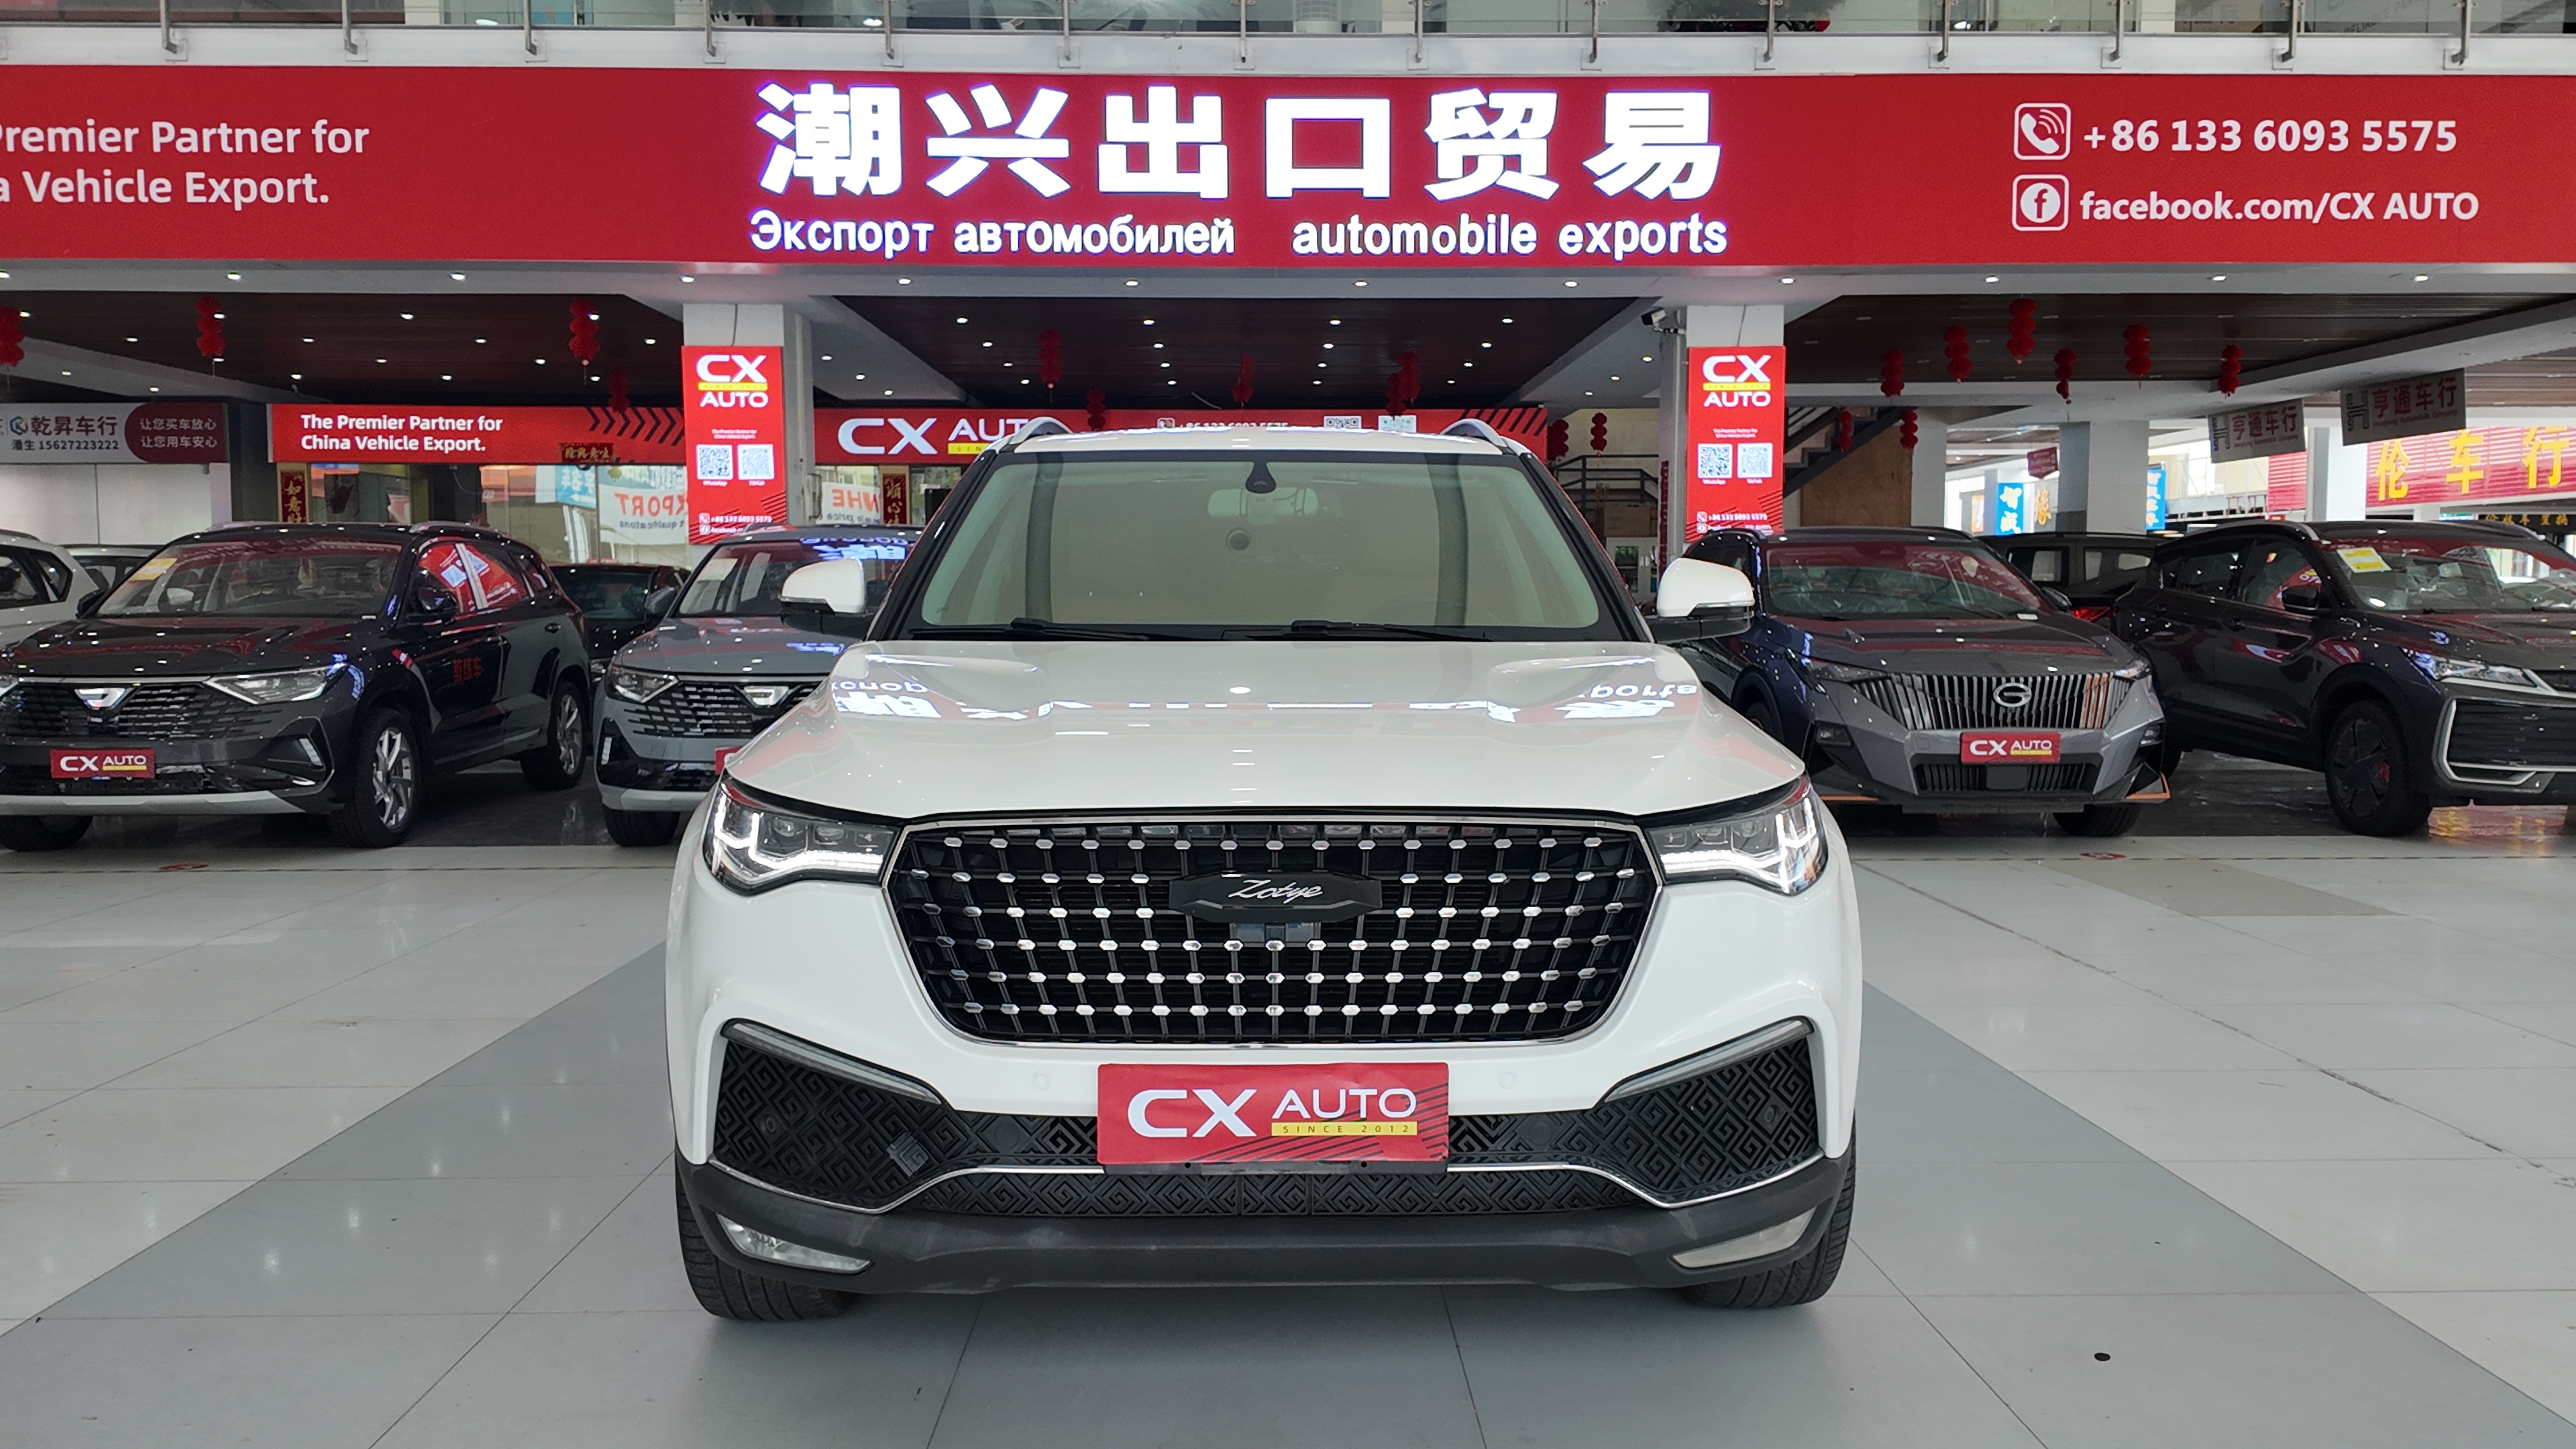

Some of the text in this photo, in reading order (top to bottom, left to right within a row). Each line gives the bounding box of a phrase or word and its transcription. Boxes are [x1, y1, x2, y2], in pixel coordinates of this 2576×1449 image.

[0, 119, 370, 153] remier Partner for
[755, 83, 1721, 201] 潮兴出口贸易
[2084, 119, 2457, 152] +86 133 6093 5575
[22, 168, 172, 203] Vehicle
[186, 172, 329, 211] Export.
[2080, 191, 2479, 223] facebook.com/CX AUTO
[751, 209, 1234, 259] Экспорт автомобилей
[1292, 213, 1727, 261] automobile exports
[696, 354, 767, 382] CX
[1702, 354, 1772, 382] CX
[700, 391, 769, 408] AUTO
[1703, 391, 1771, 407] AUTO
[2372, 376, 2457, 419] 亨通车行
[140, 418, 217, 431] 让您买车放心
[300, 414, 503, 431] The Premier Partner for
[838, 417, 1029, 455] CX AUT
[2232, 405, 2298, 440] 亨通车行
[38, 439, 119, 450] 15627223222
[141, 435, 218, 448] 让您用车安心
[301, 434, 486, 454] China Vehicle Export.
[1970, 740, 2007, 755] CX
[2010, 740, 2053, 750] AUTO
[60, 756, 99, 771] CX
[103, 755, 147, 765] AUTO
[1228, 879, 1323, 904] Zotye
[1127, 1088, 1417, 1138] CX AUTO
[1283, 1125, 1409, 1134] SINCE 2012
